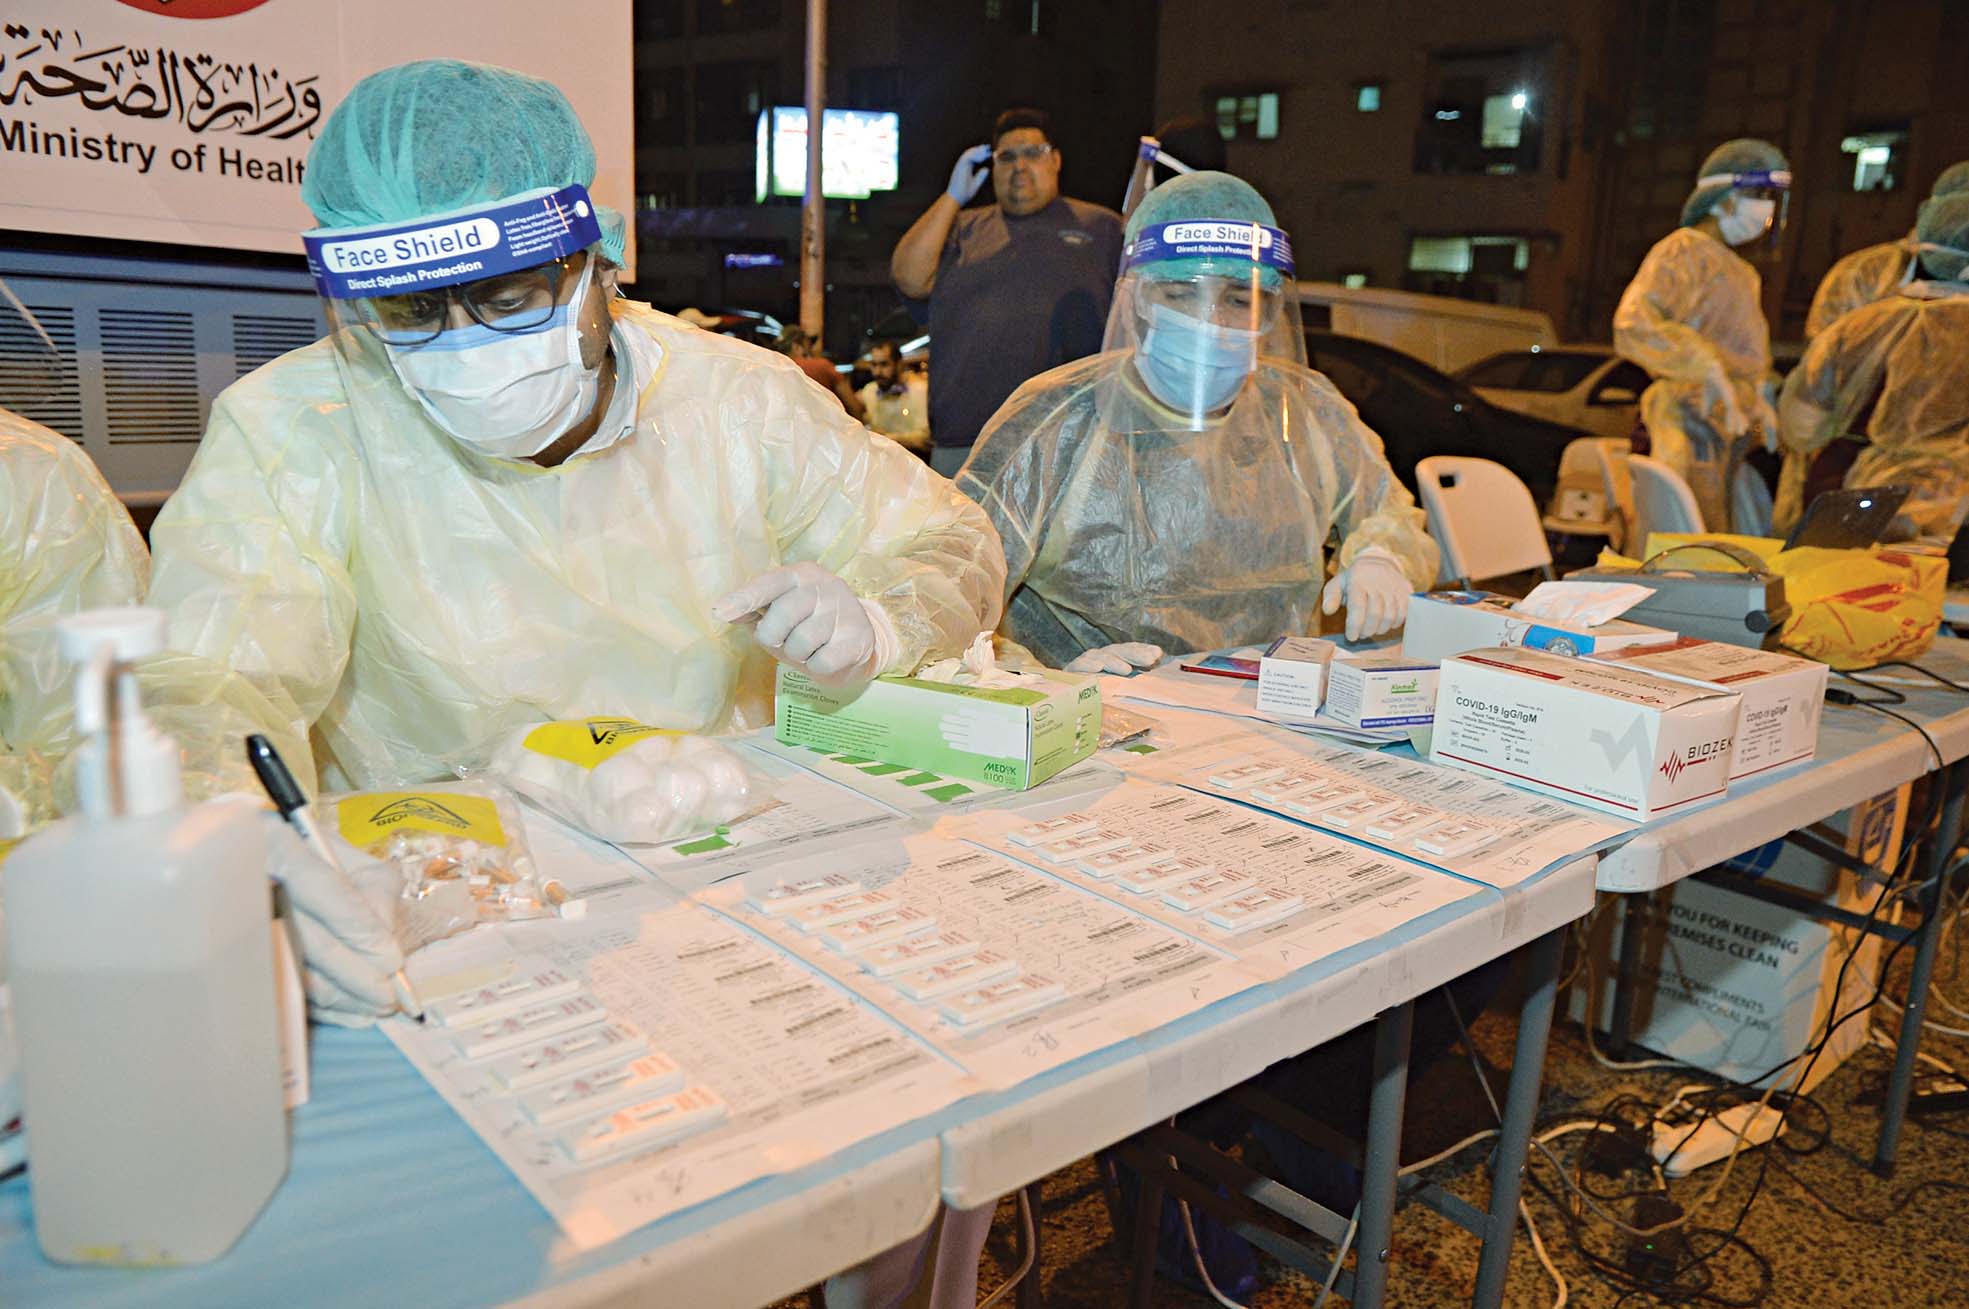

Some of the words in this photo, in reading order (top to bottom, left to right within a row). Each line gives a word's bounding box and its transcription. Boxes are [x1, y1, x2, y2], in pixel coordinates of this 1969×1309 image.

[0, 118, 156, 174] Ministry
[171, 144, 206, 172] of
[220, 146, 304, 185] Healt
[333, 246, 389, 269] Face
[392, 224, 482, 262] Shield
[1175, 227, 1211, 240] Face
[1198, 245, 1224, 254] Splash
[347, 276, 377, 290] Direct
[378, 271, 417, 289] Splash
[418, 260, 483, 282] Protection
[1455, 696, 1499, 714] COVID-19
[1501, 707, 1538, 723] IgG/IgM
[1687, 736, 1734, 759] BIOZEK
[1700, 912, 1731, 933] FOR
[1733, 921, 1800, 954] KEEPING
[1728, 941, 1779, 968] CLEAN
